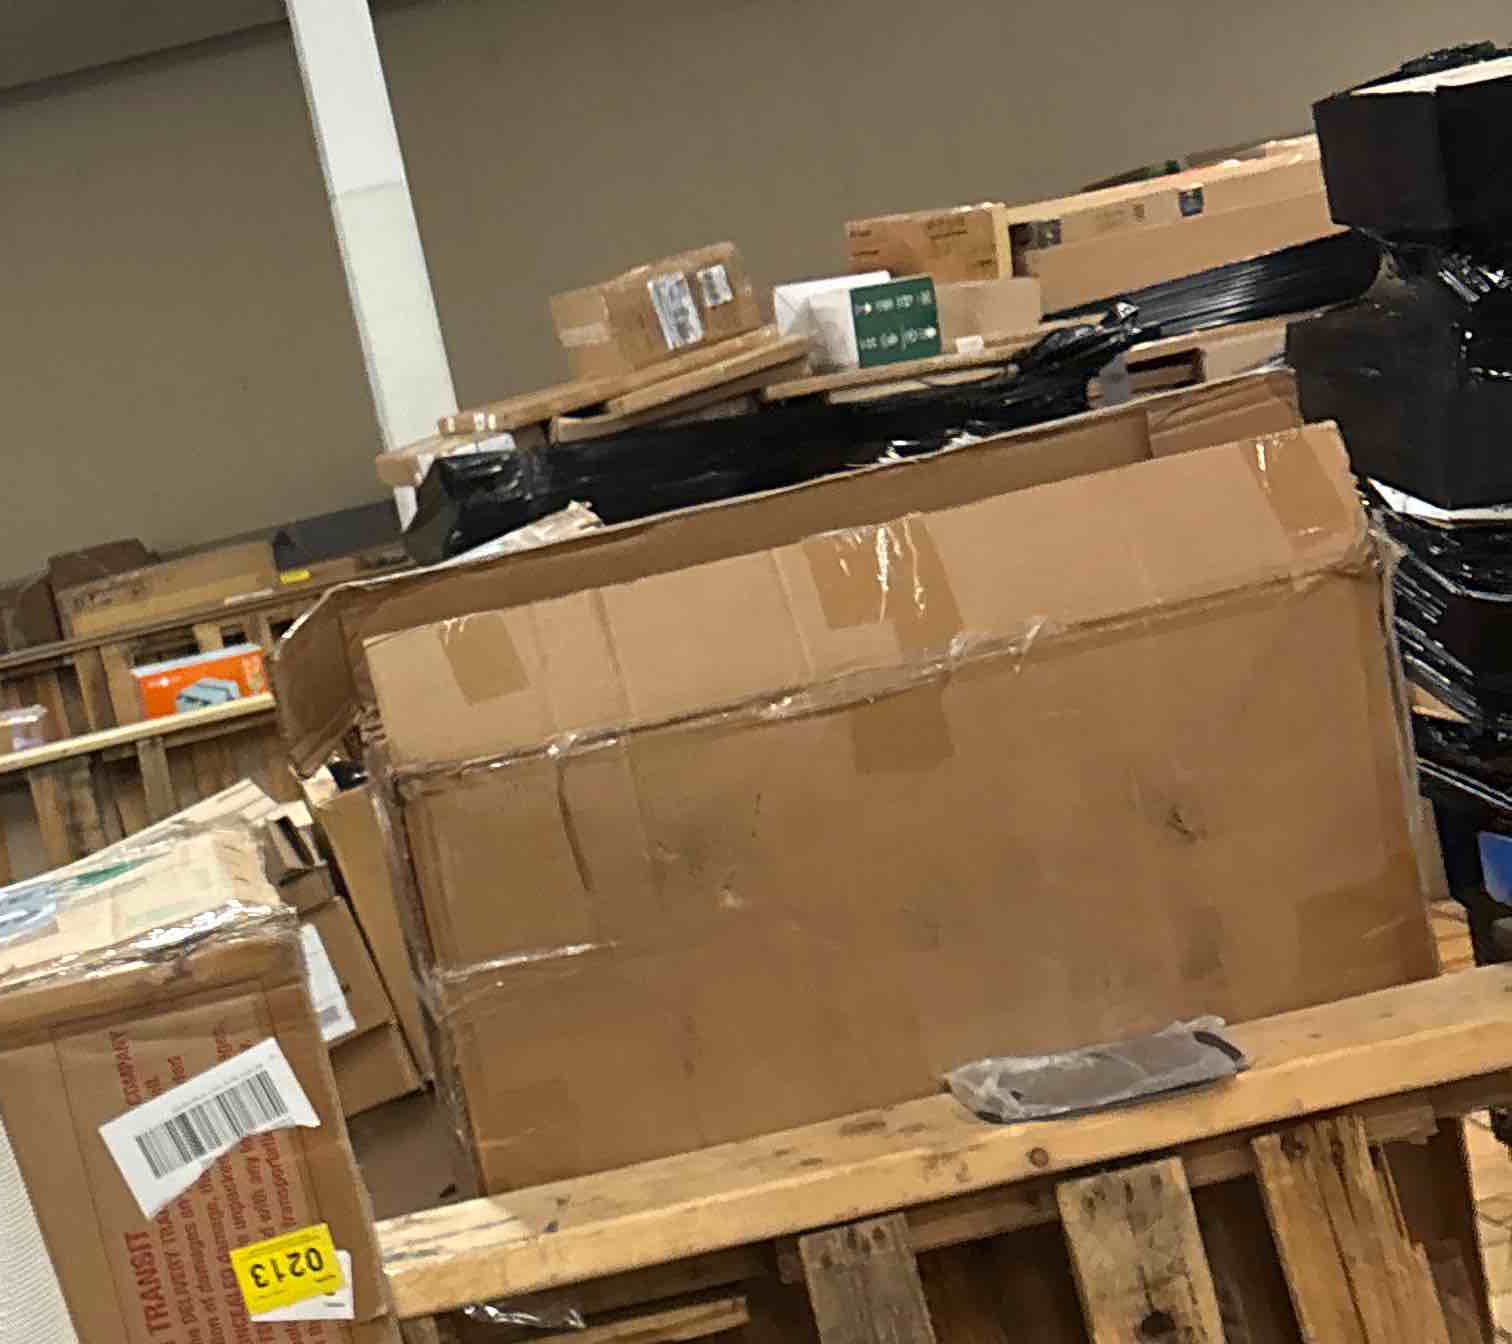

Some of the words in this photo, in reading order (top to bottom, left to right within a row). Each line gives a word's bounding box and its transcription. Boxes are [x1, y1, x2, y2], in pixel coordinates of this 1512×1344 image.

[121, 1227, 173, 1334] TRANSIT
[163, 1247, 198, 1326] DELIVERY
[177, 1213, 217, 1294] damages
[247, 1245, 326, 1290] 0213
